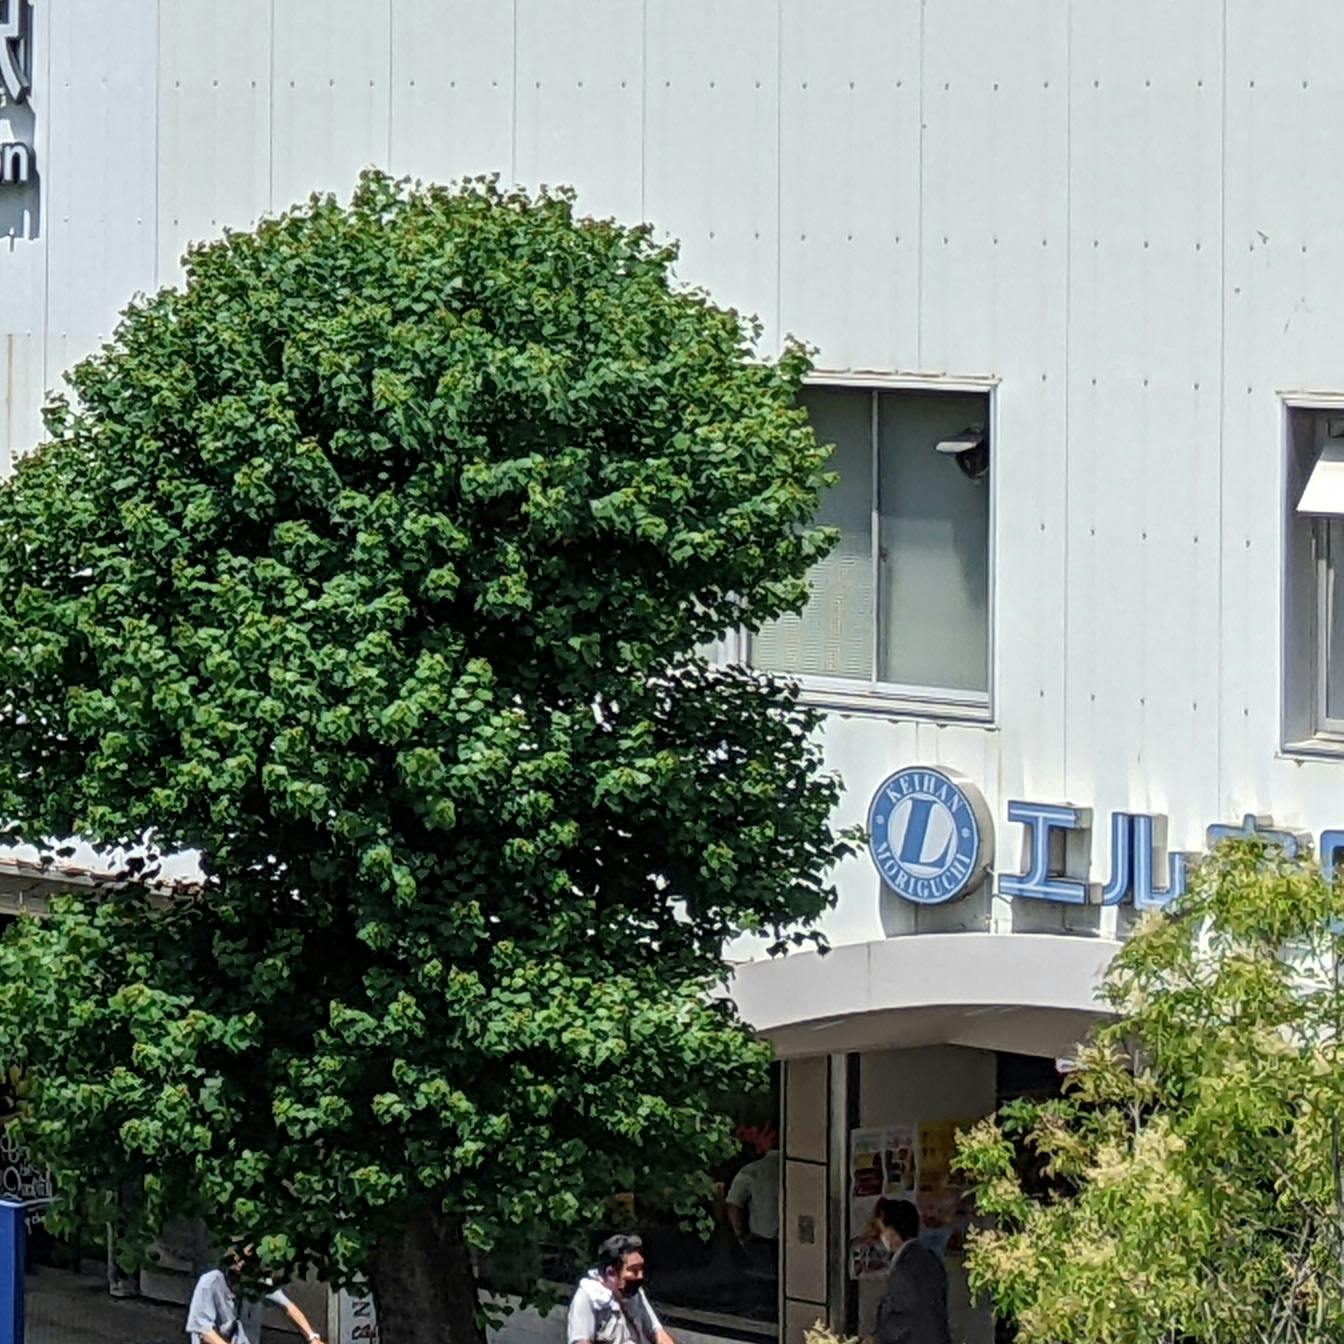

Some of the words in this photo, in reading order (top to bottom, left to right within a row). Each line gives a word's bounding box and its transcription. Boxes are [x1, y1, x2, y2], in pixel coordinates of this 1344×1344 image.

[885, 774, 964, 814] KEIHAN
[900, 797, 953, 869] L
[877, 842, 971, 898] MORIGUCHI
[999, 800, 1344, 938] エル
